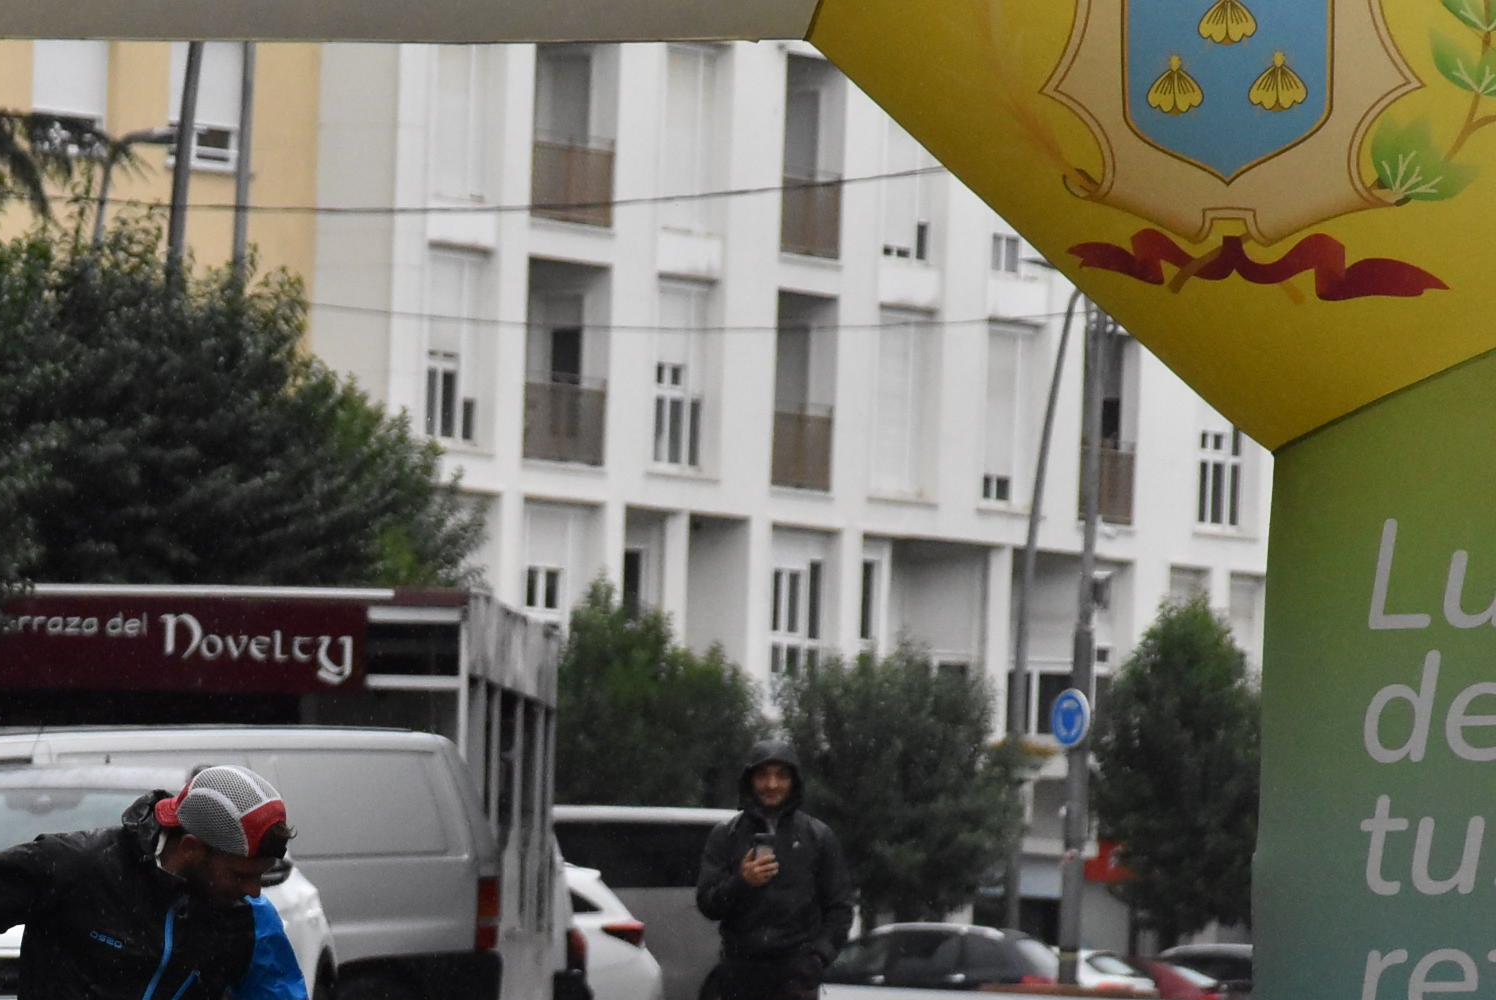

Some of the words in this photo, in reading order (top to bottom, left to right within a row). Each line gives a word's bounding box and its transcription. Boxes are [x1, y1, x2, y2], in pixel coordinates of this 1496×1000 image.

[105, 613, 148, 636] del
[160, 613, 353, 685] Novelty
[1363, 649, 1496, 764] de
[1360, 794, 1496, 895] tu
